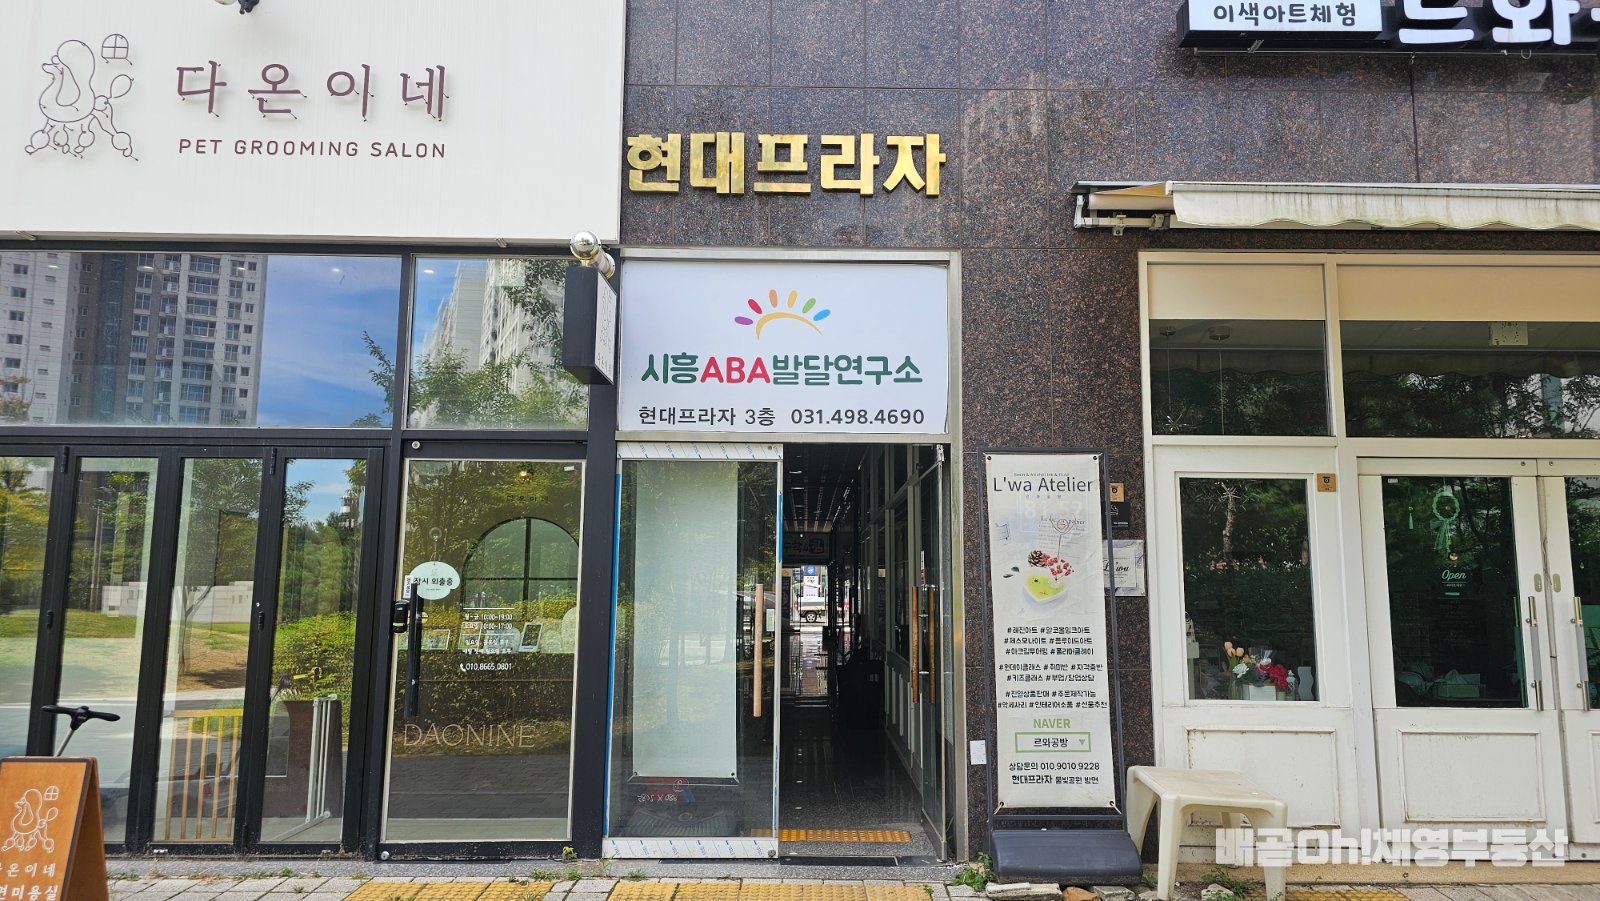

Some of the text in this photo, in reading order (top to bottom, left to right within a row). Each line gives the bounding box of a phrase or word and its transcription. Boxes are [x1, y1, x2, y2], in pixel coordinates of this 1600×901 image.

[1213, 1, 1357, 27] 이색아트체험
[175, 60, 451, 122] 다온이네
[179, 138, 446, 158] PET GROOMING SALON
[626, 131, 947, 197] 현대프라자
[640, 352, 923, 386] 시흥ABA발달연구소
[638, 406, 925, 427] 현대프라자 3층 031.498.4690
[993, 478, 1094, 492] L'wa Atelier
[1442, 570, 1466, 581] Open
[1071, 664, 1103, 672] #자격증반
[1033, 719, 1071, 728] NAVER
[404, 722, 536, 749] DAONINE
[1034, 738, 1068, 748] 르와공방
[1009, 762, 1100, 771] 상담문의 010.9010.9228
[1012, 775, 1052, 785] 현대프라자
[1084, 777, 1099, 785] 방면
[0, 863, 56, 877] 온이네
